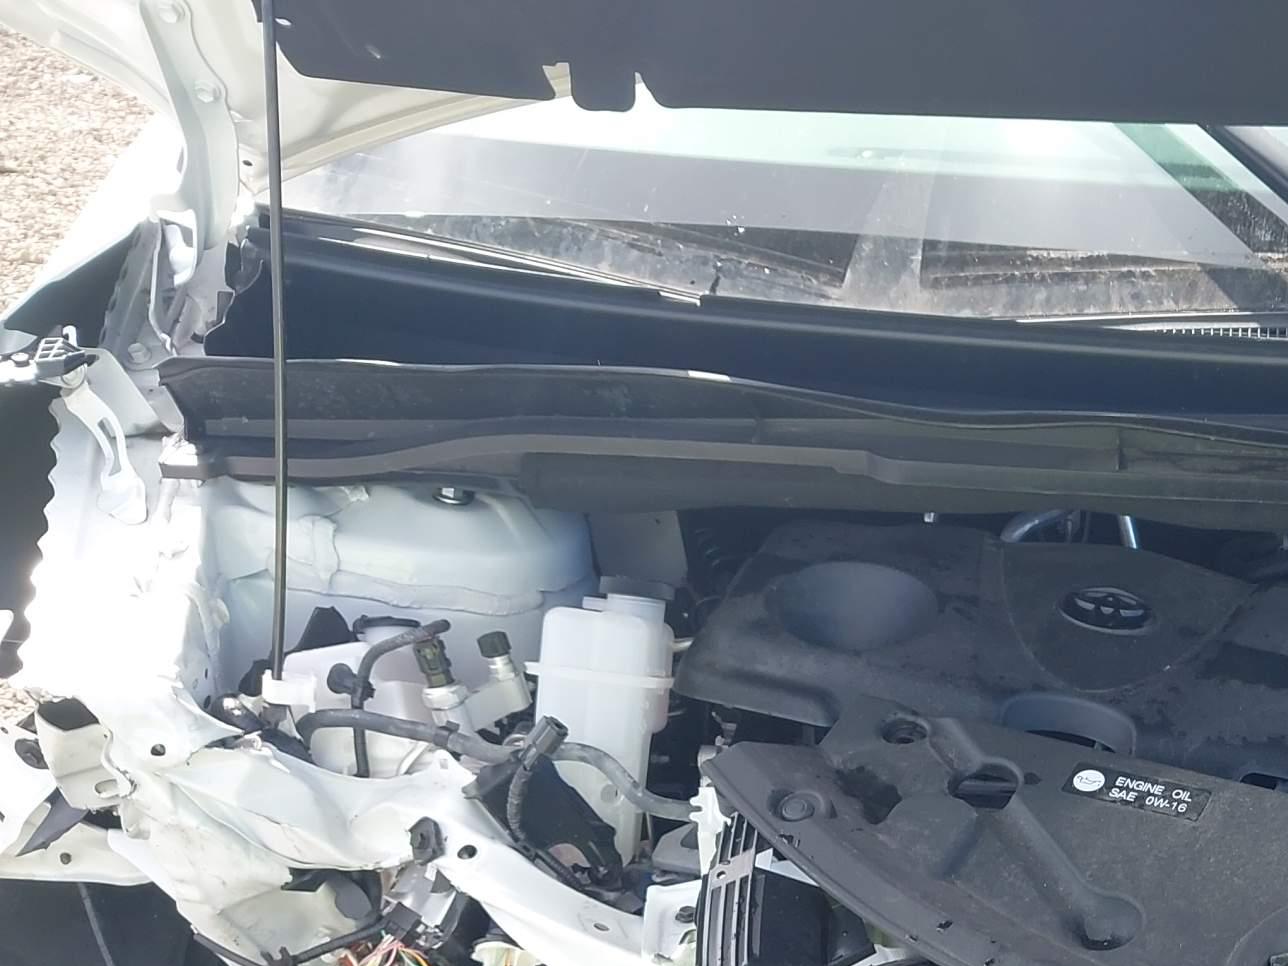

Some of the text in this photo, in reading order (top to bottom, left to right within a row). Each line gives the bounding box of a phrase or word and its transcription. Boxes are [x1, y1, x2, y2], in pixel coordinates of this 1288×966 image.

[1108, 788, 1188, 813] SAE 0W-16
[1115, 776, 1192, 802] ENGINE OIL
